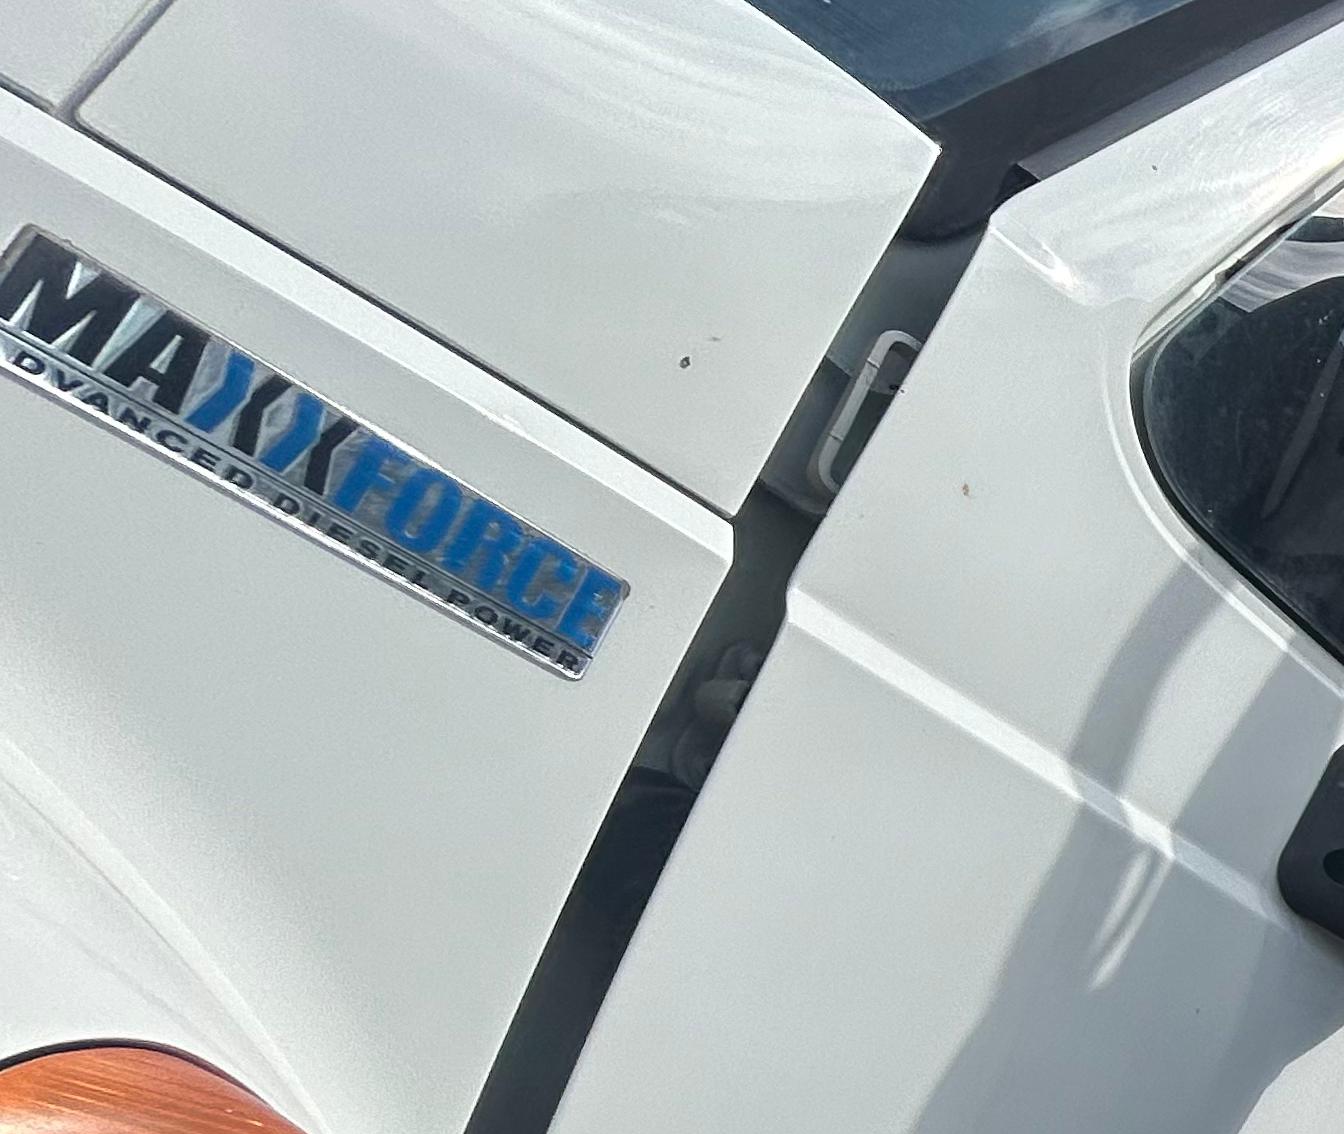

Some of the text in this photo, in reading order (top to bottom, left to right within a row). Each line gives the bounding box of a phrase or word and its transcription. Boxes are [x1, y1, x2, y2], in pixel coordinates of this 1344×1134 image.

[0, 233, 625, 650] MAXXFORCE
[11, 350, 580, 673] DVANCED DIESEL POWER
